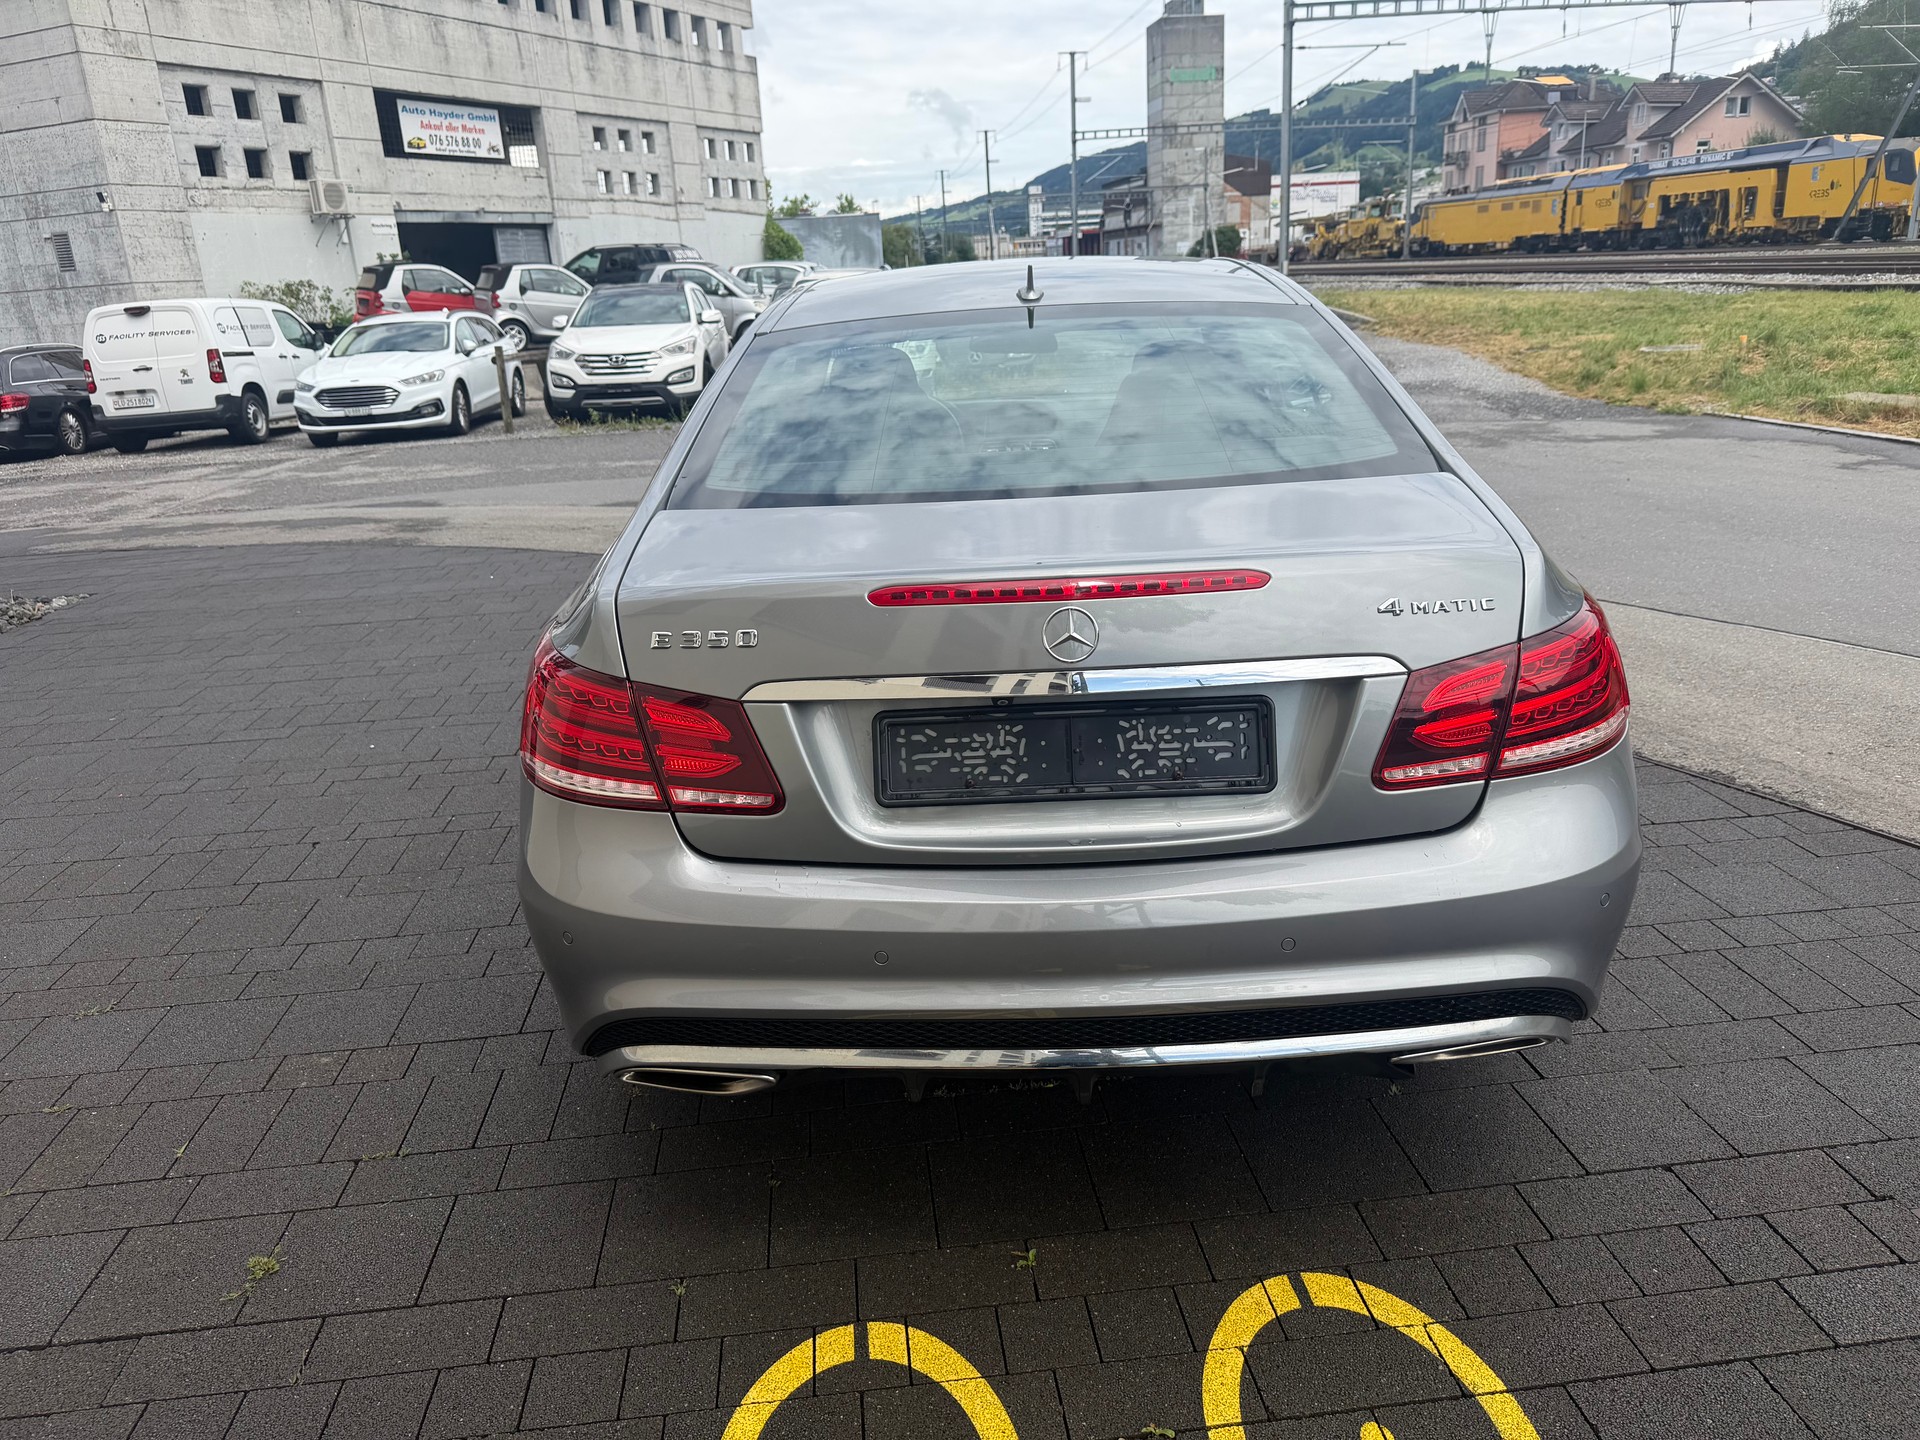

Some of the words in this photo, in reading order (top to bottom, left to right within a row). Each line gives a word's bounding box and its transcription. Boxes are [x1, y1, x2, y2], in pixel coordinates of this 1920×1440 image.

[401, 105, 426, 115] Auto
[429, 108, 465, 120] Hayder
[467, 112, 497, 123] GmbH
[420, 120, 444, 131] Ankauf
[445, 122, 460, 133] aller
[461, 124, 486, 135] Marken
[428, 134, 444, 146] 076
[446, 135, 460, 147] 576
[461, 136, 471, 148] 88
[472, 137, 482, 149] 00
[1700, 154, 1726, 163] DYNAMIC
[1809, 188, 1830, 199] KREBS
[108, 332, 146, 341] FACILITY
[148, 329, 191, 337] SERVICES
